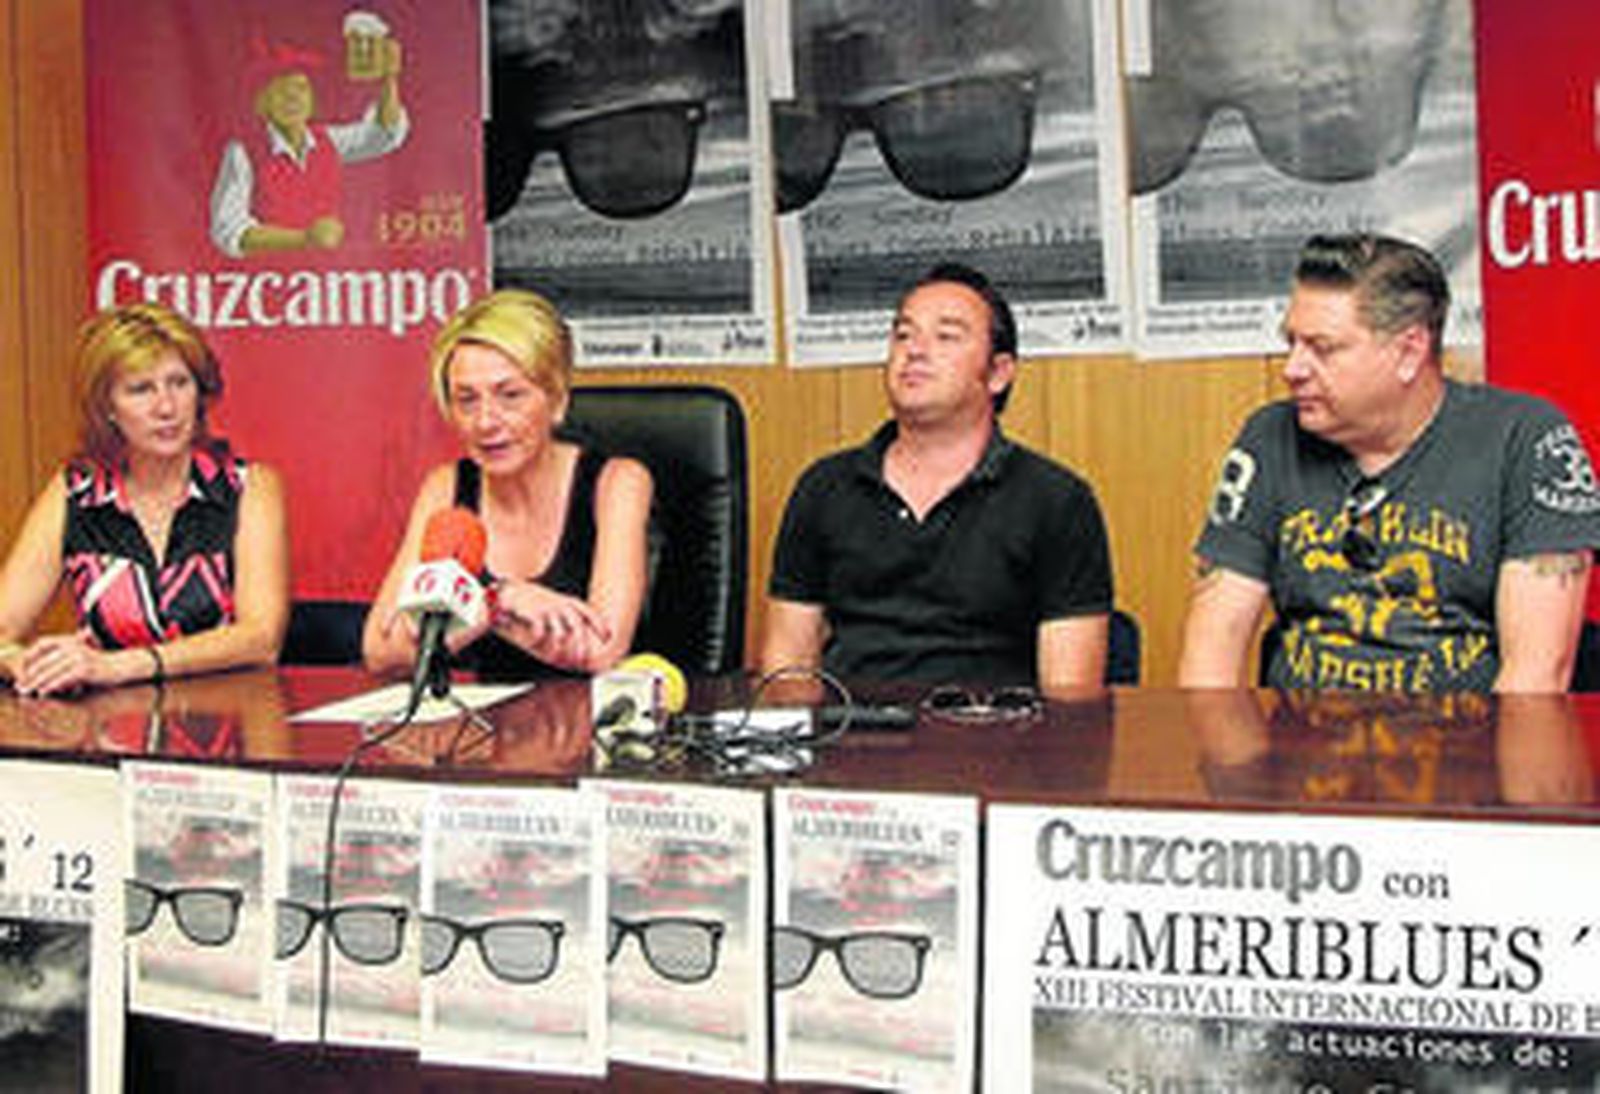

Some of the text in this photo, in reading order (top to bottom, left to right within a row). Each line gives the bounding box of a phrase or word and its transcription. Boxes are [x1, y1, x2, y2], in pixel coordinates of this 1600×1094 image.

[96, 261, 471, 335] Cruzcampo
[1036, 819, 1451, 901] Cruzcampo con
[1034, 906, 1544, 993] ALMERIBLUES
[1097, 979, 1245, 1015] FESTIVAL
[1251, 986, 1523, 1029] INTERNACIONAL
[1531, 1002, 1577, 1032] DE
[1287, 1031, 1495, 1066] actuaciones
[1512, 1039, 1570, 1068] de:
